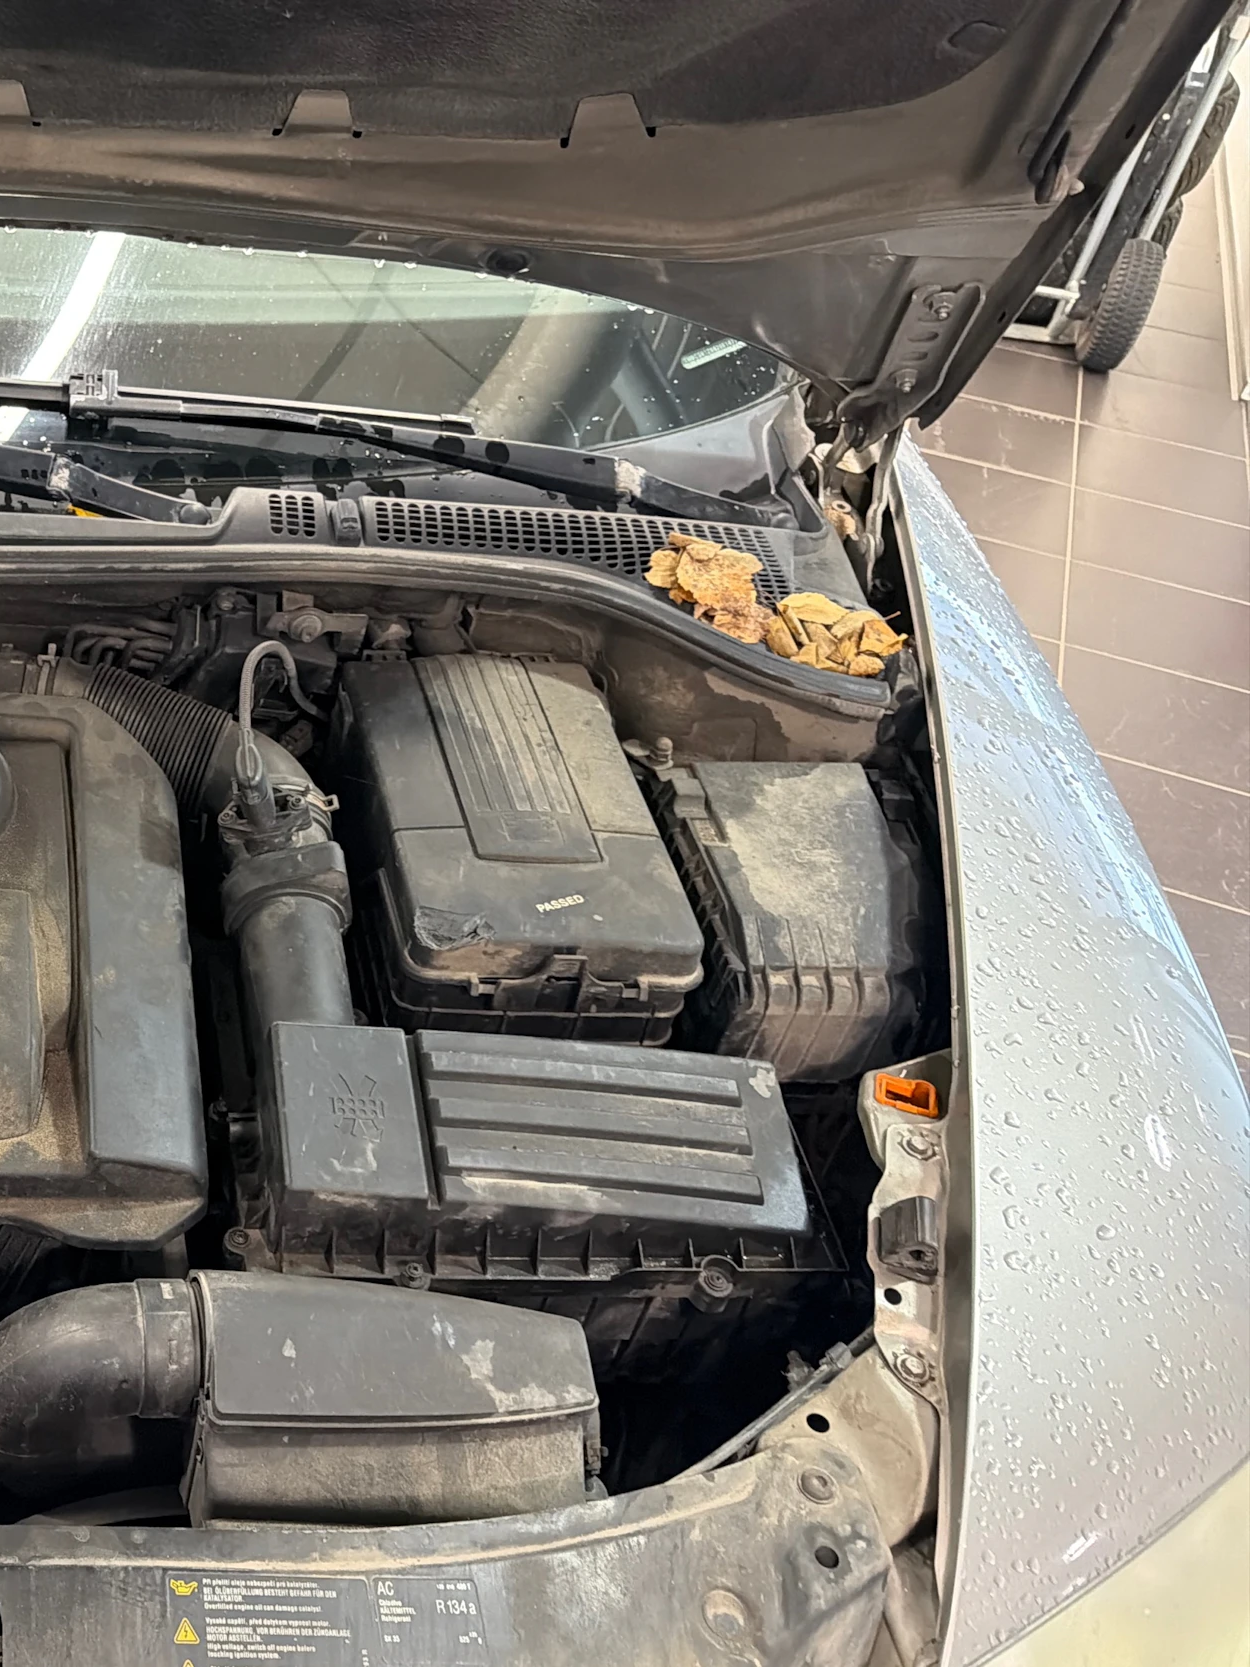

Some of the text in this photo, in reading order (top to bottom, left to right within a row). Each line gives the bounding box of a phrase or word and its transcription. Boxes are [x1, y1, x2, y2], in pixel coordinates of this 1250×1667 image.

[536, 894, 584, 912] PASSED
[378, 1581, 394, 1596] AC
[234, 1604, 253, 1612] engine
[275, 1604, 298, 1612] damage
[436, 1600, 476, 1614] R 134 a
[301, 1628, 312, 1636] DER
